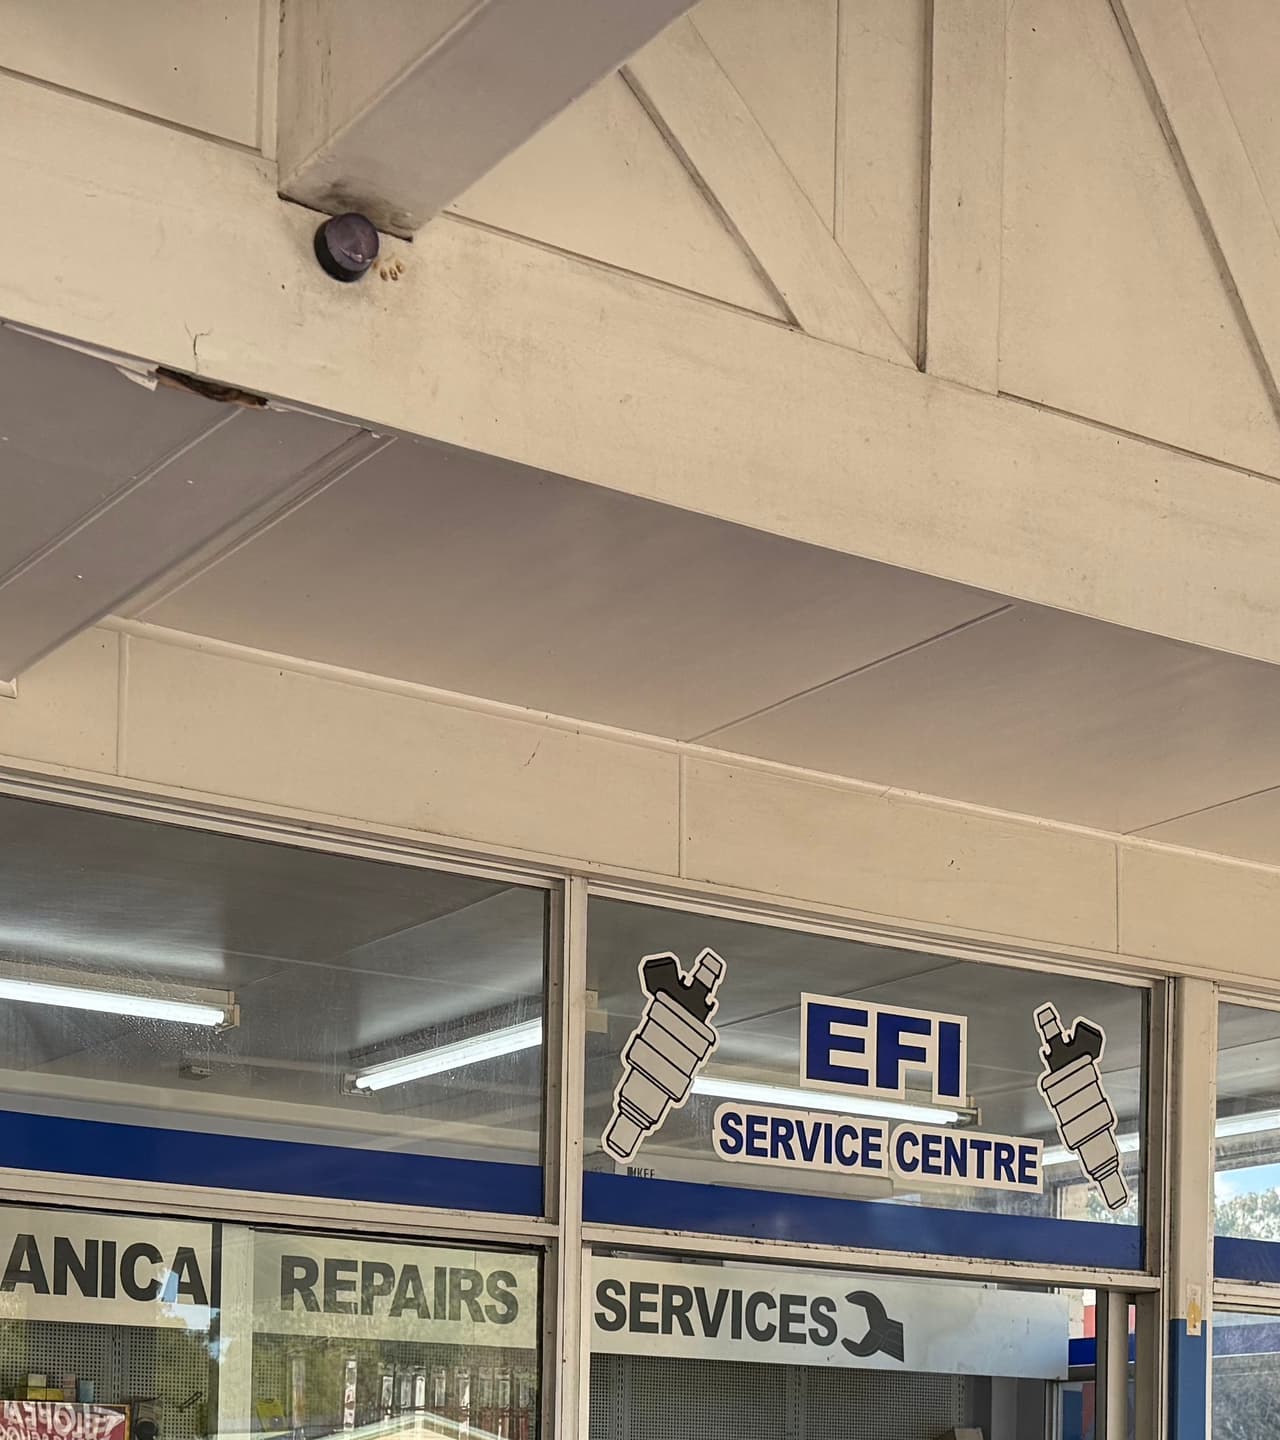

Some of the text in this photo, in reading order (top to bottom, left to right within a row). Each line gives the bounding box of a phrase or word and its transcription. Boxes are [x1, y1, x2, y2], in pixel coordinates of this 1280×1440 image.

[806, 1001, 961, 1098] EFI
[718, 1111, 1039, 1186] SERVICE CENTRE
[279, 1253, 519, 1325] REPAIRS
[594, 1278, 839, 1347] SERVICES
